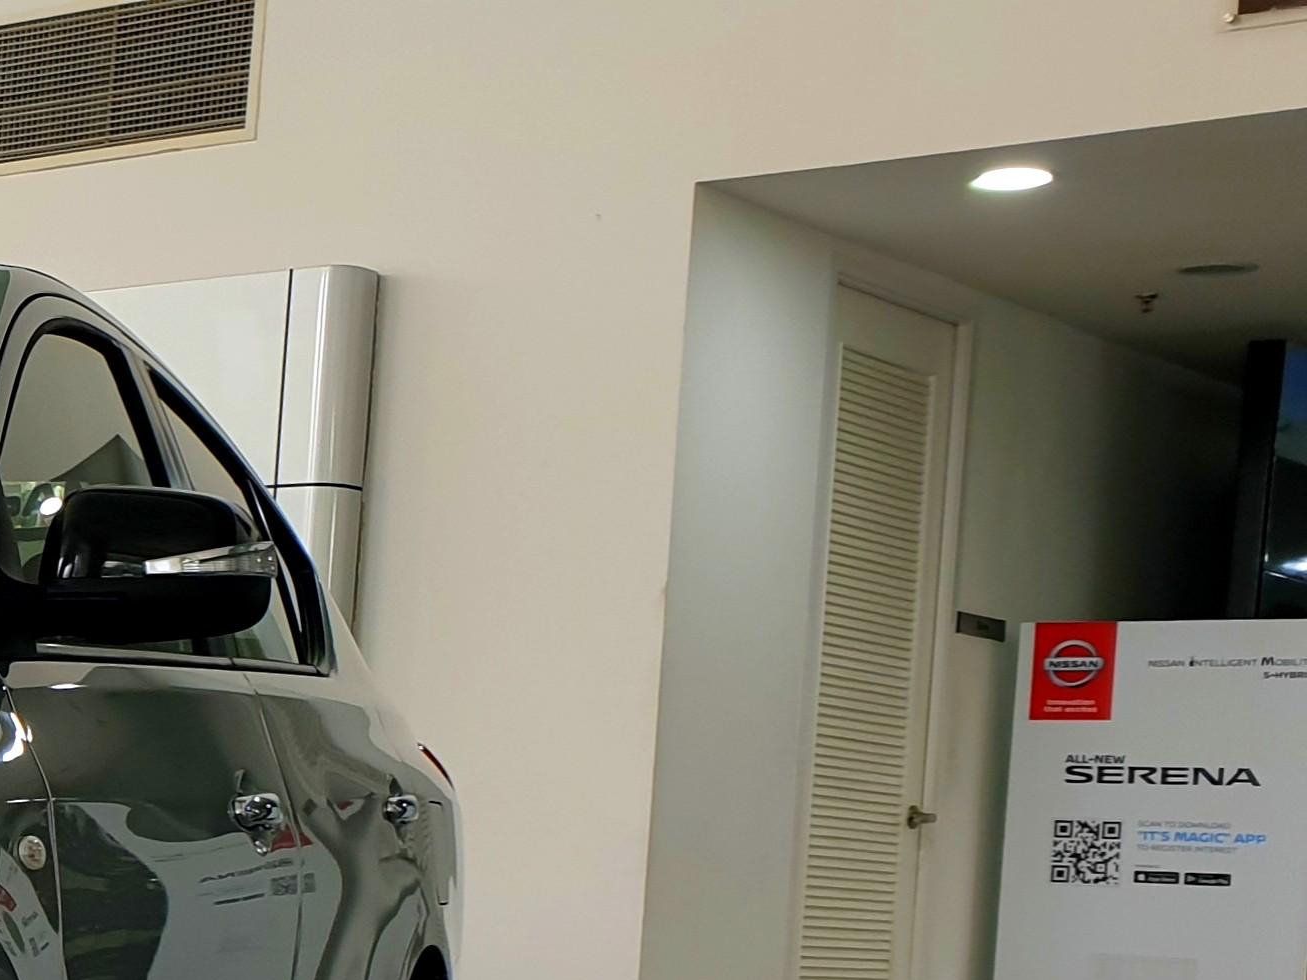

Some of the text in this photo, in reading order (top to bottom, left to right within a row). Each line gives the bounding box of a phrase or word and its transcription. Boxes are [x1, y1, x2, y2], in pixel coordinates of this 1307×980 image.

[1049, 660, 1098, 668] NISSAN
[1065, 754, 1126, 764] ALL-NEW
[1064, 766, 1261, 787] SERENA
[1234, 834, 1267, 844] APP
